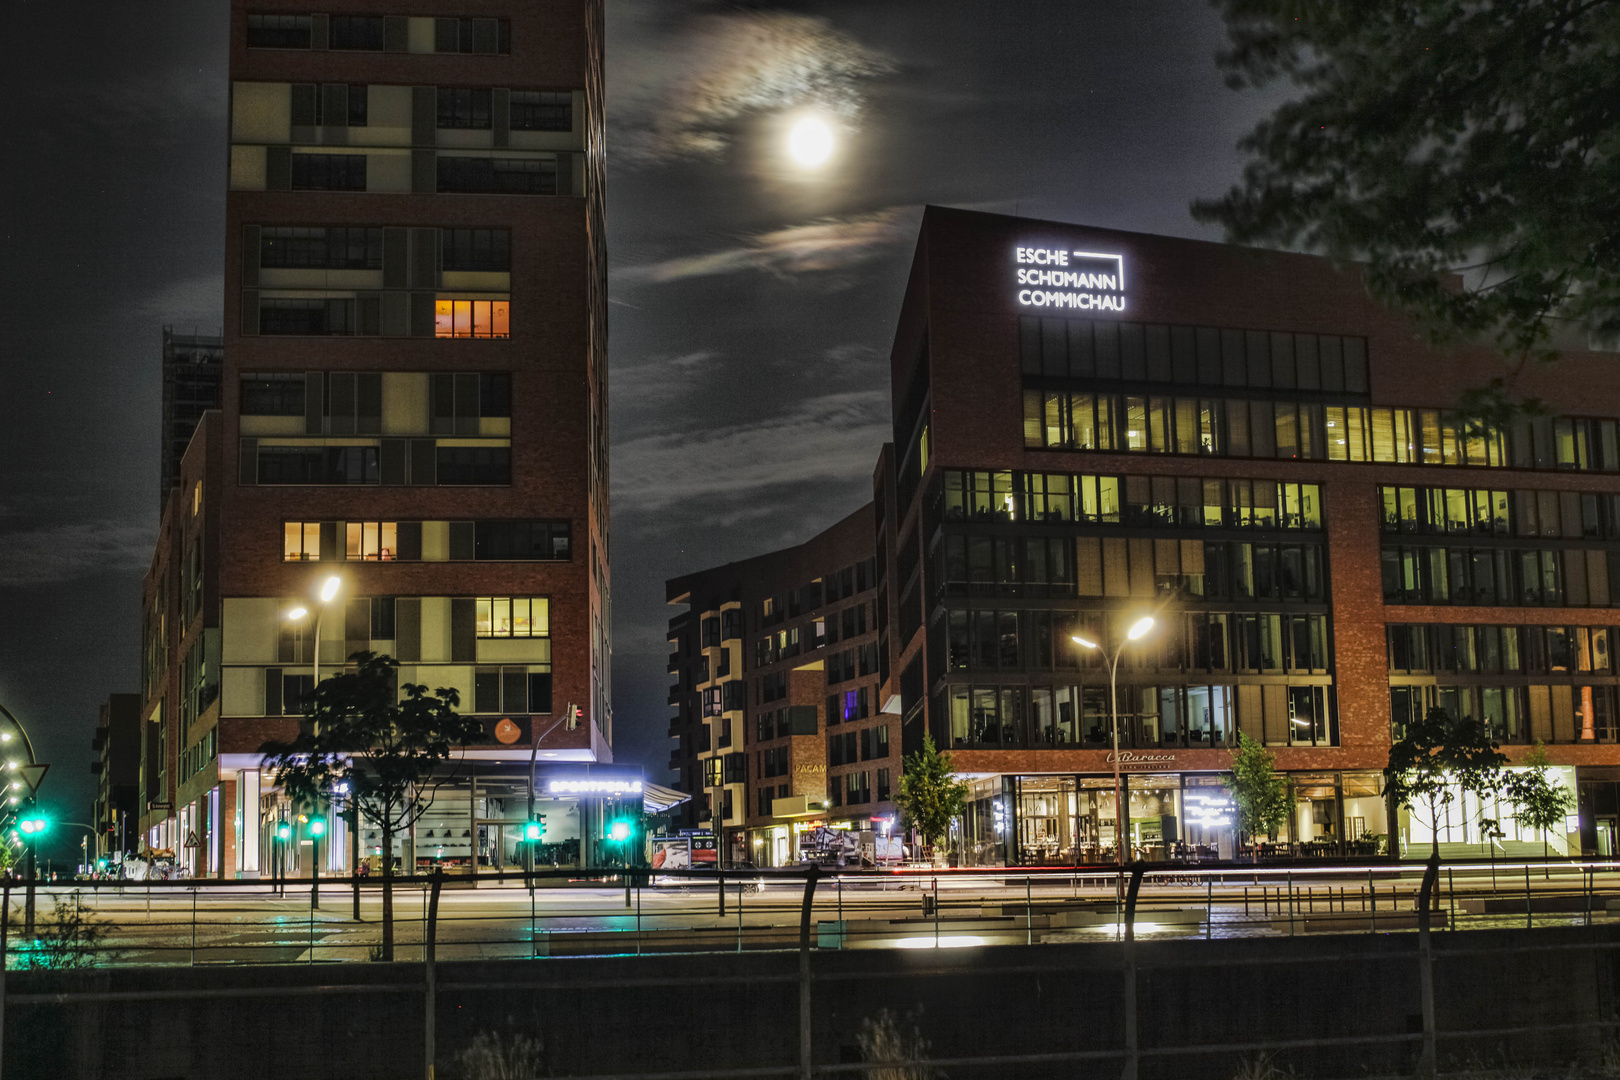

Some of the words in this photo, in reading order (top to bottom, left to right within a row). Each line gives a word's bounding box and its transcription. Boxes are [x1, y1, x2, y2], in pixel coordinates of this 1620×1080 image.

[1016, 247, 1069, 266] ESCHE
[1017, 268, 1116, 290] SCHÜMANN
[1018, 290, 1126, 311] COMMICHAU
